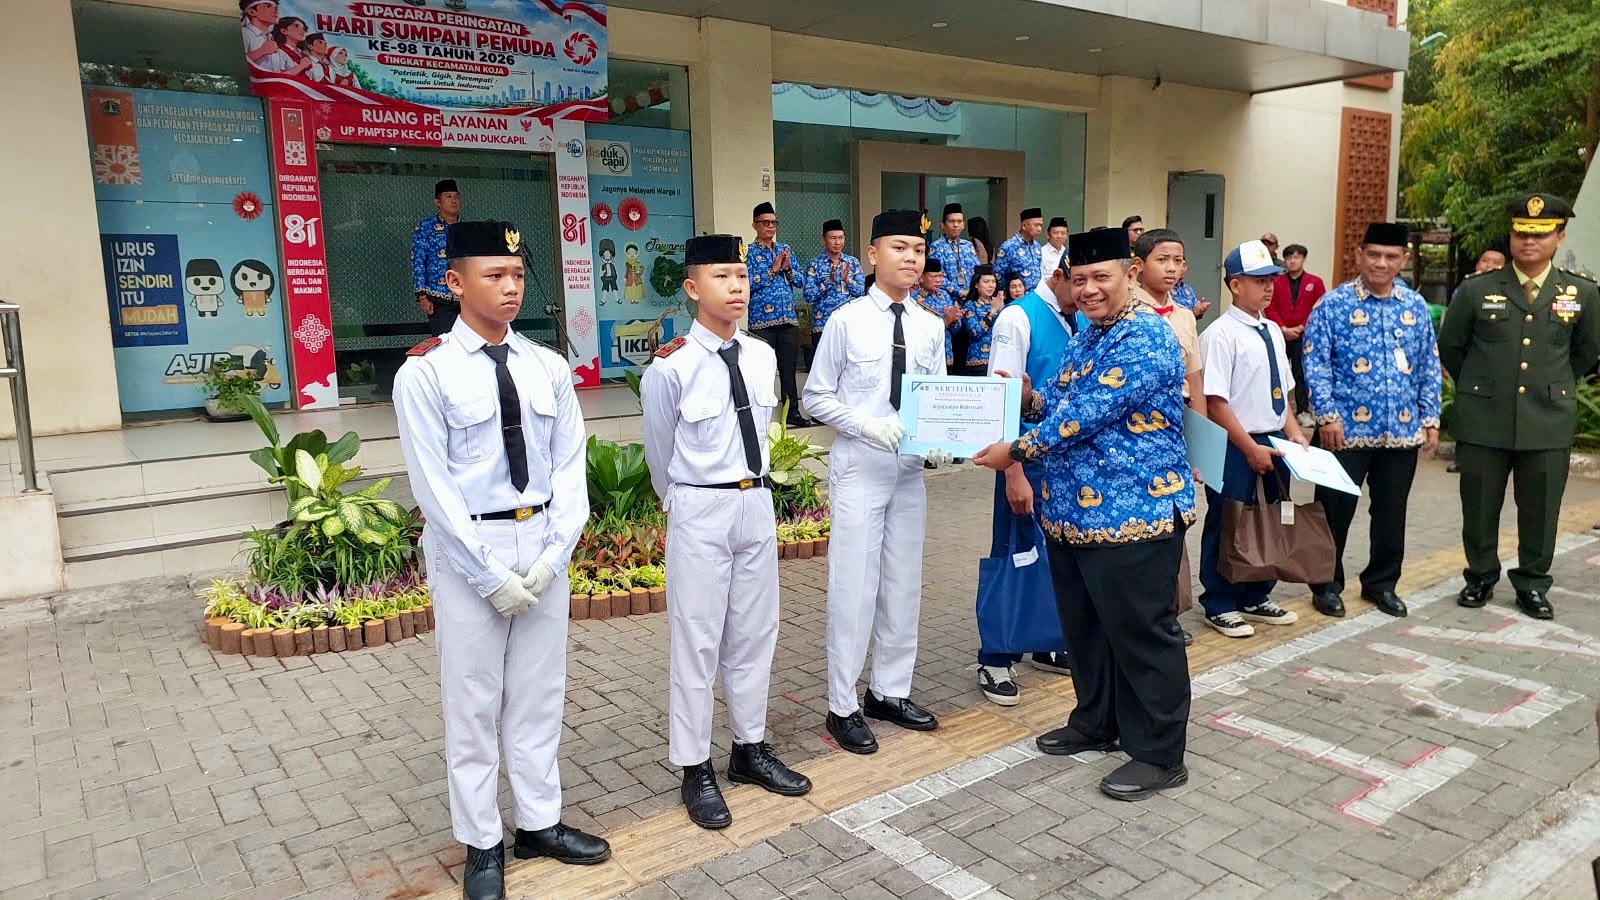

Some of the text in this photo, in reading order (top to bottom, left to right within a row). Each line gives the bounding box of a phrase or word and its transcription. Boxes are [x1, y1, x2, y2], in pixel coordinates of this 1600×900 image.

[363, 4, 521, 34] UPACARA PERINGATAN
[316, 13, 556, 58] HARI SUMPAH PEMUDA
[368, 40, 515, 65] KE-98 TAHUN 2026
[383, 55, 504, 75] TINGKAT KECAMATAN KOJA
[400, 78, 431, 86] Pemuda
[456, 74, 493, 84] Berempati
[138, 104, 154, 114] UNIT
[137, 118, 152, 128] DAN
[153, 119, 191, 130] PELAYANAN
[241, 124, 260, 134] PINTU
[362, 108, 508, 131] RUANG PELAYANAN
[173, 133, 213, 145] KECAMATAN
[340, 126, 355, 137] UP
[358, 127, 400, 139] PMPTSP
[457, 133, 478, 144] DAN
[481, 134, 527, 145] DUKCAPIL
[602, 156, 625, 169] capil
[279, 174, 317, 183] DIRGAHAYU
[558, 175, 586, 183] DIRGAHAYU
[282, 184, 315, 192] REPUBLIK
[601, 184, 627, 195] Jagonya
[629, 186, 655, 195] Melayani
[657, 187, 676, 197] Warga
[281, 193, 317, 202] INDONESIA
[560, 191, 587, 199] INDONESIA
[284, 214, 320, 248] 81
[562, 213, 588, 247] 81
[115, 242, 156, 256] URUS
[117, 258, 145, 273] IZIN
[288, 259, 323, 267] INDONESIA
[287, 268, 325, 276] BERDAULAT
[119, 274, 173, 288] SENDIRI
[292, 277, 323, 286] ADIL DAN
[294, 287, 323, 295] MAKMUR
[121, 291, 145, 305] ITU
[124, 309, 176, 323] MUDAH
[625, 339, 650, 353] IKD
[934, 385, 985, 393] SERTIFIKAT
